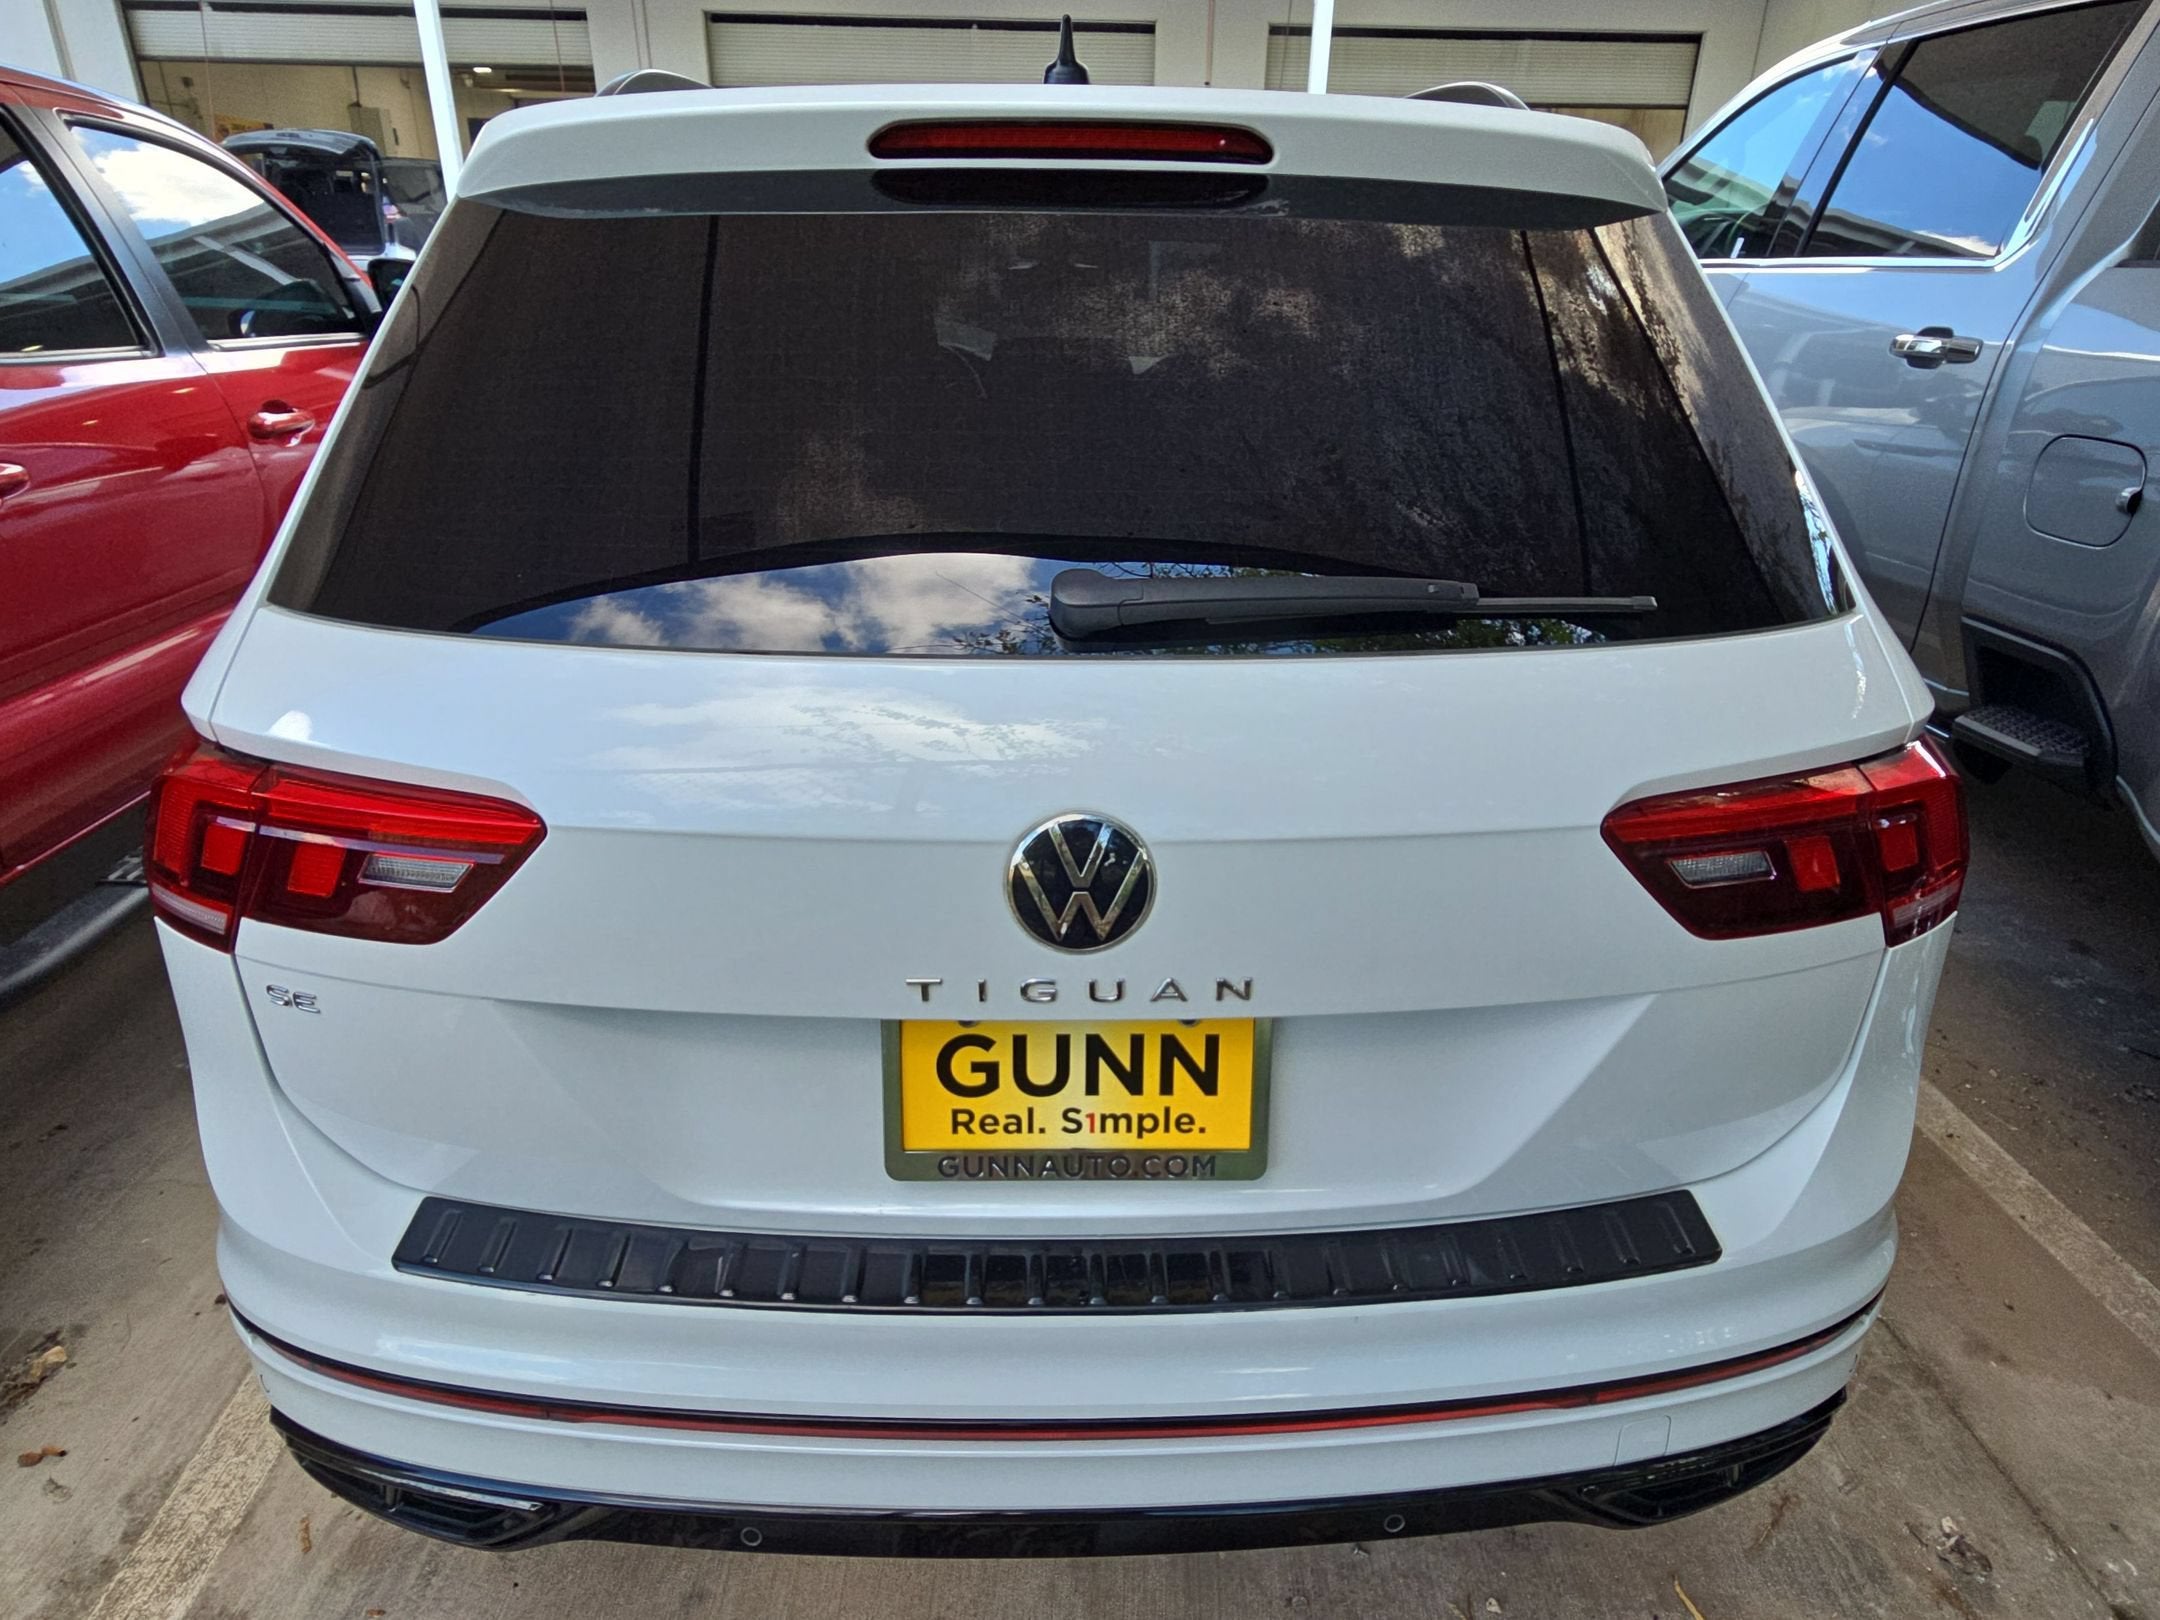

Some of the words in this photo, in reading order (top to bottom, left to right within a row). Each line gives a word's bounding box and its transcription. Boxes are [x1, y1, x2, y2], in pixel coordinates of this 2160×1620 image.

[1012, 818, 1150, 945] VW
[266, 984, 321, 1014] SE
[905, 977, 1253, 1003] TIGUAN
[936, 1033, 1220, 1098] GUNN
[951, 1107, 1046, 1135] Real.
[1061, 1106, 1206, 1139] S1mple.
[937, 1155, 1217, 1179] GUNNAUTO.COM
